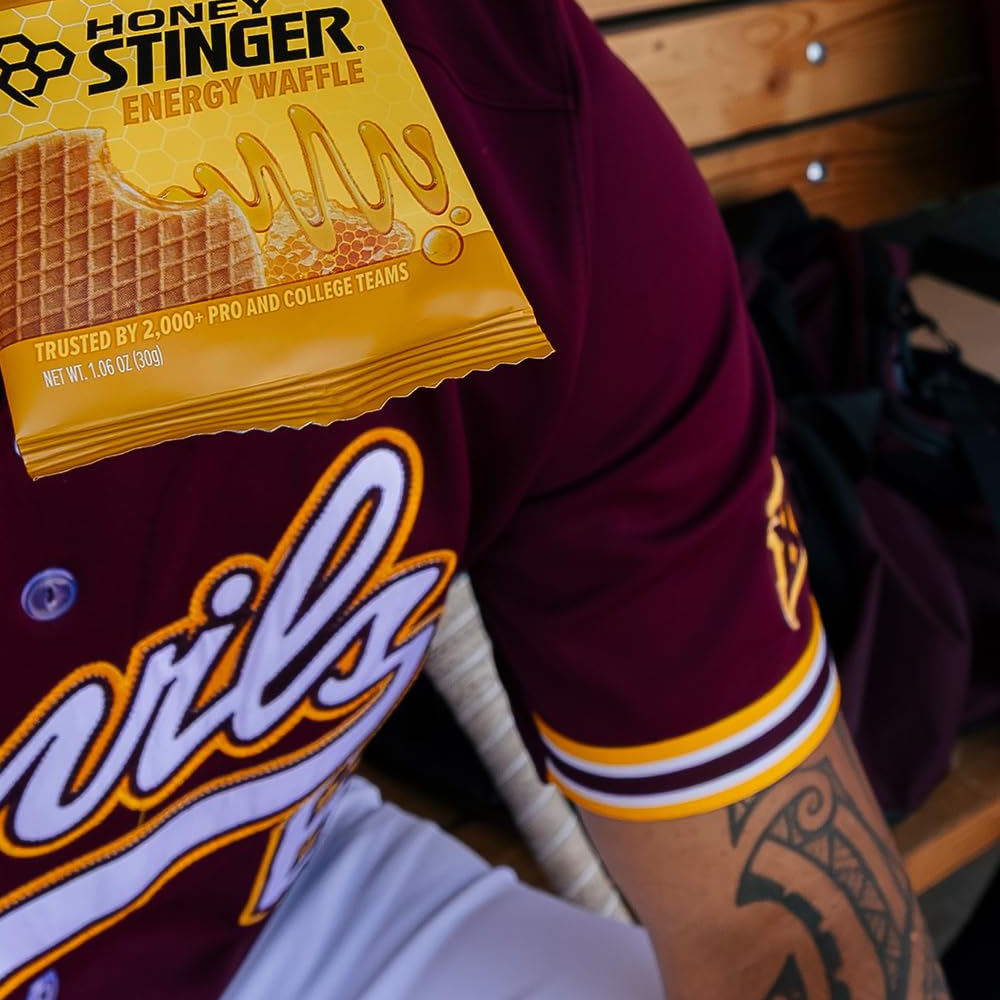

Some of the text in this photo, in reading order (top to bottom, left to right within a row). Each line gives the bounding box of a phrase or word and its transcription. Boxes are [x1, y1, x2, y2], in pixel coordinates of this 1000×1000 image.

[87, 7, 357, 97] STINGER
[121, 58, 364, 126] ENERGY WAFFLE
[34, 262, 410, 362] TRUSTED BY 2,000+ PRO AND COLLEGE TEAMS
[42, 344, 164, 388] NET WT. 1.06 OZ (30g)
